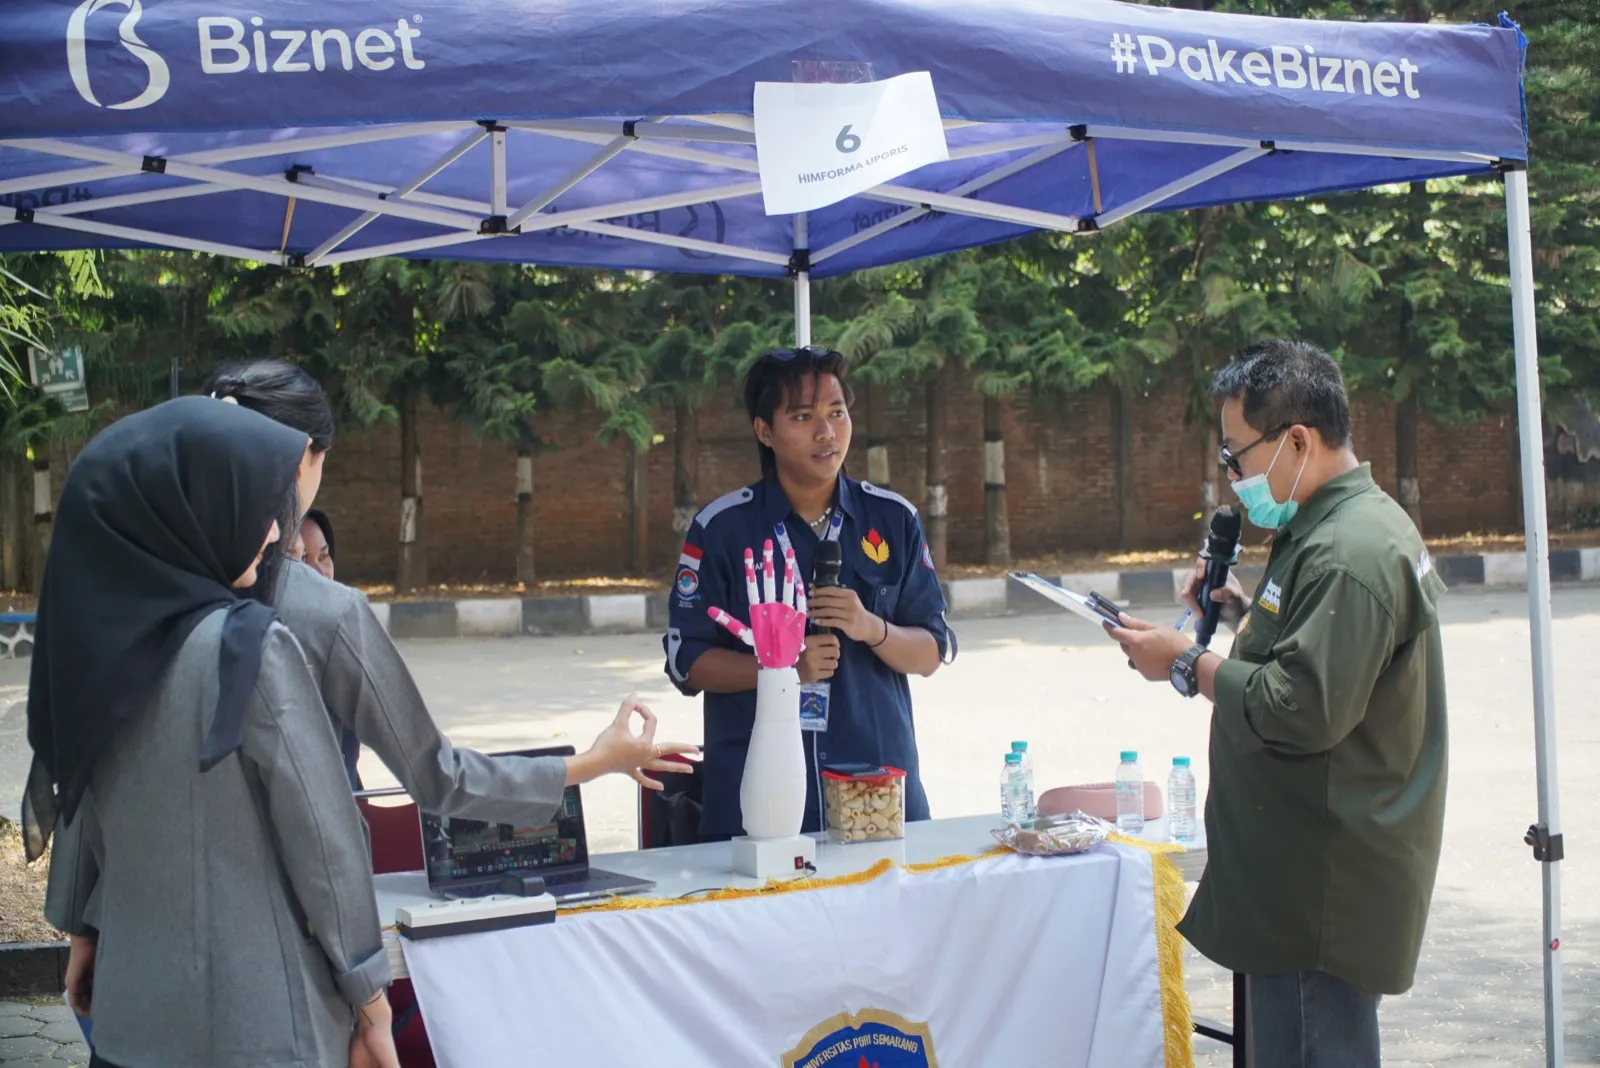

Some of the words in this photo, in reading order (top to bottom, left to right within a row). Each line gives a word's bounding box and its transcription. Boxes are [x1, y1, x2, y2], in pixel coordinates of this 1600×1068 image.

[198, 16, 425, 74] Biznet
[1110, 32, 1421, 99] #PakeBiznet
[835, 124, 861, 154] 6
[798, 161, 864, 184] HIMFORMA
[866, 144, 908, 166] UPGRIS
[803, 1039, 853, 1068] NIVERSITAS
[852, 1034, 872, 1049] PGRI
[872, 1033, 919, 1054] SEMARANG
